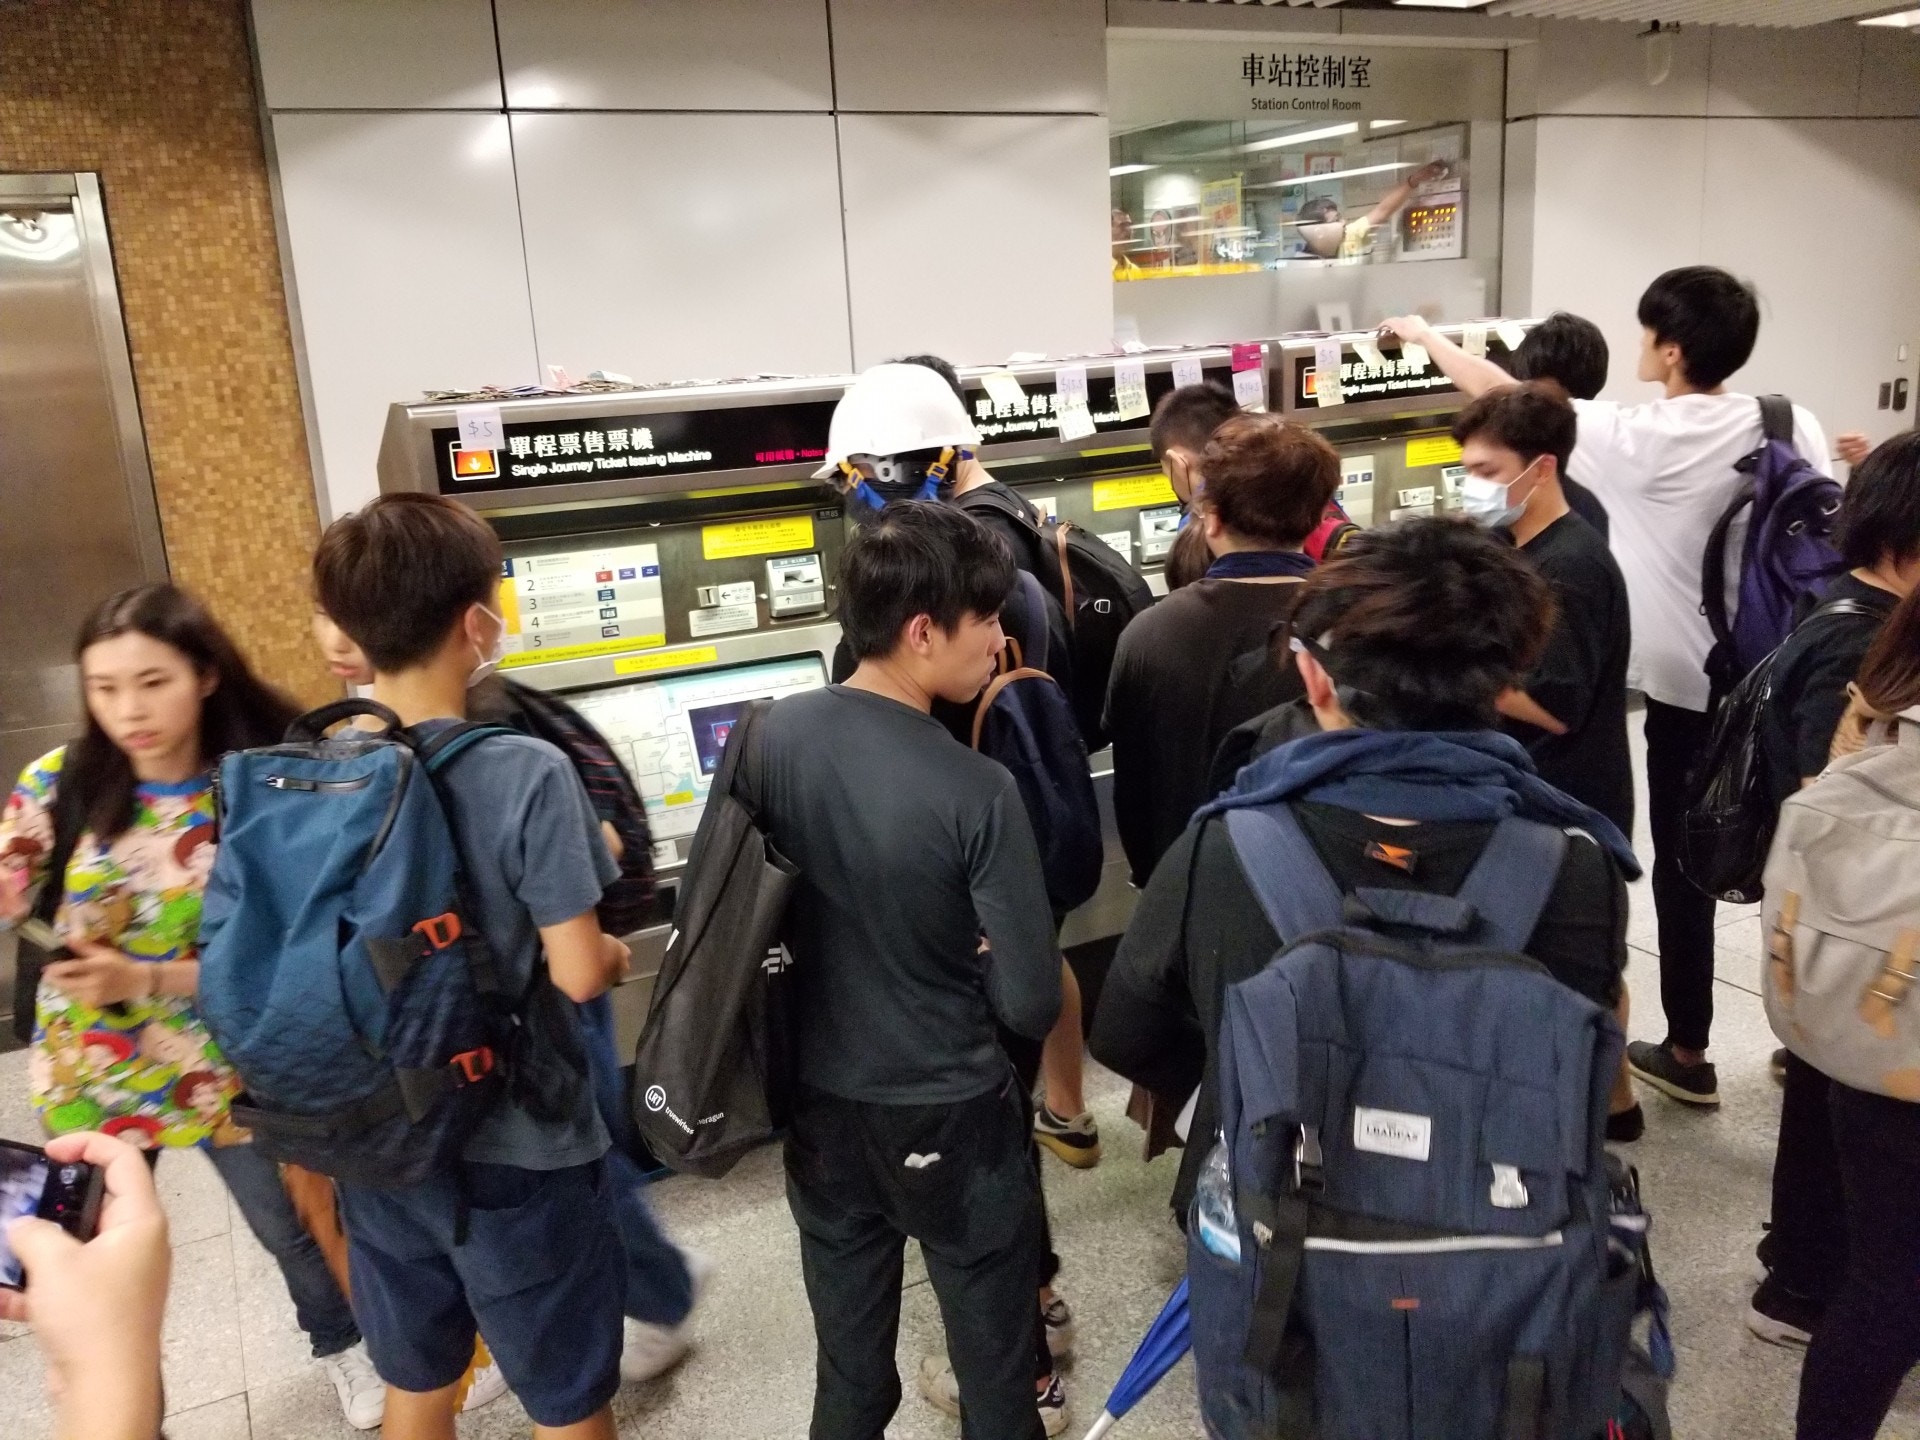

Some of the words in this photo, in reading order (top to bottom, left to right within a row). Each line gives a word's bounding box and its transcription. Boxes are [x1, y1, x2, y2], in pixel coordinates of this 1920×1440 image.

[1241, 53, 1371, 88] 車站控制室
[1251, 97, 1289, 110] Station
[1291, 97, 1330, 110] Control
[1332, 98, 1361, 110] Room
[1360, 383, 1388, 394] Journey
[1387, 379, 1407, 391] Ticket
[468, 419, 494, 438] $5
[1003, 420, 1038, 432] Journey
[509, 427, 655, 460] 單程票售票機
[511, 463, 548, 477] Single
[548, 459, 594, 474] Journey
[595, 456, 628, 470] Ticket
[629, 452, 667, 468] Issuing
[667, 449, 713, 464] Machine
[526, 561, 532, 572] 1
[527, 580, 535, 591] 2
[529, 599, 537, 610] 3
[531, 617, 540, 628] 4
[534, 636, 542, 647] 5
